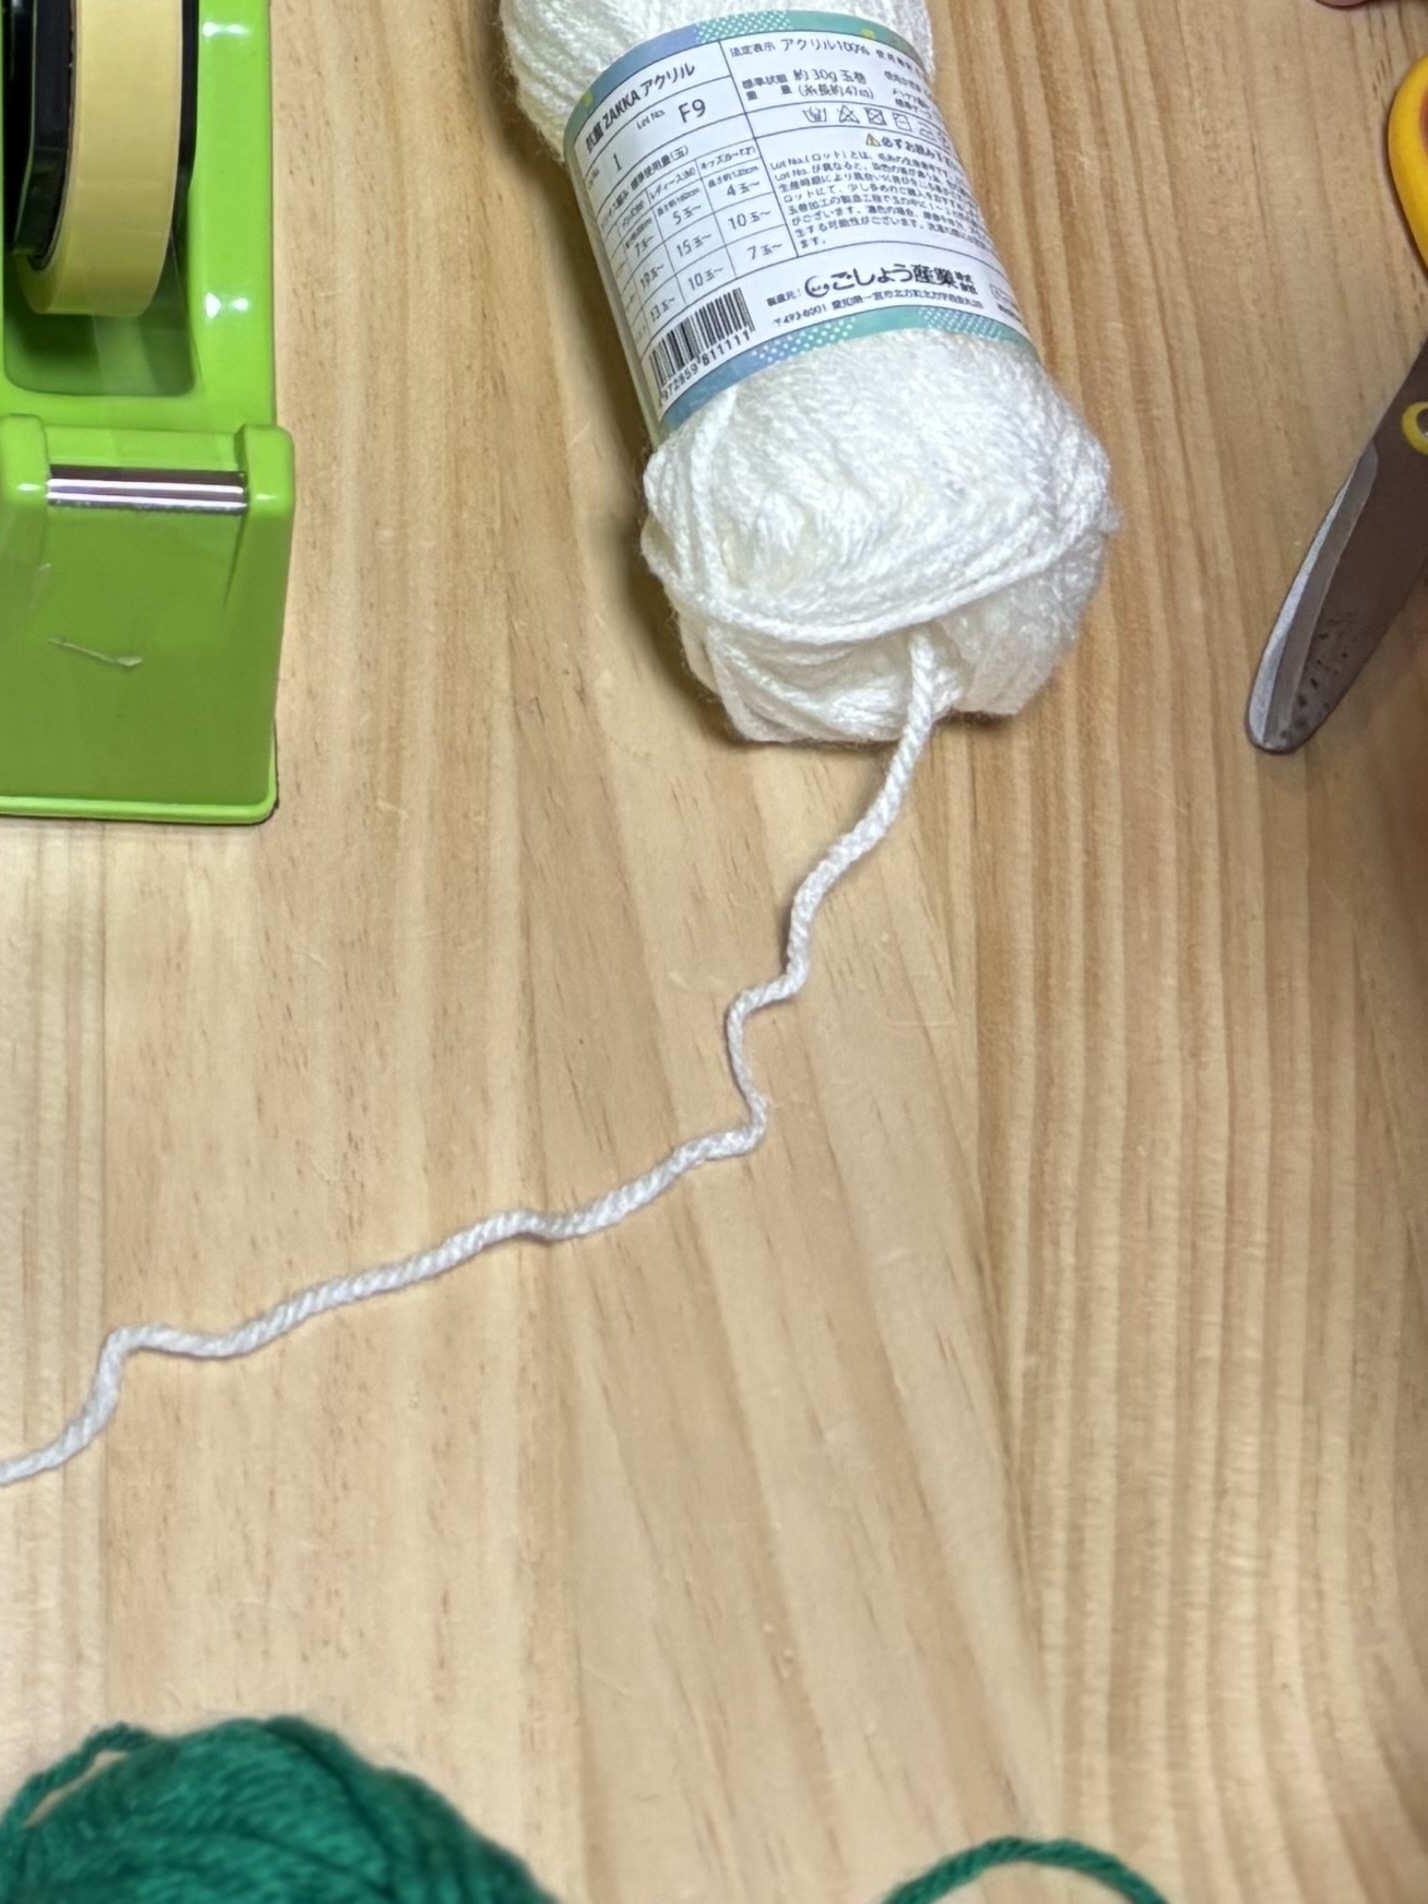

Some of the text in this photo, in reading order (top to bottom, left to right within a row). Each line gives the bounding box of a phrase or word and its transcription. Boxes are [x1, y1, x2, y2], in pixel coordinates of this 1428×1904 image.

[602, 90, 641, 130] ZAKKA
[640, 62, 696, 97] アクリル
[678, 98, 707, 124] F9
